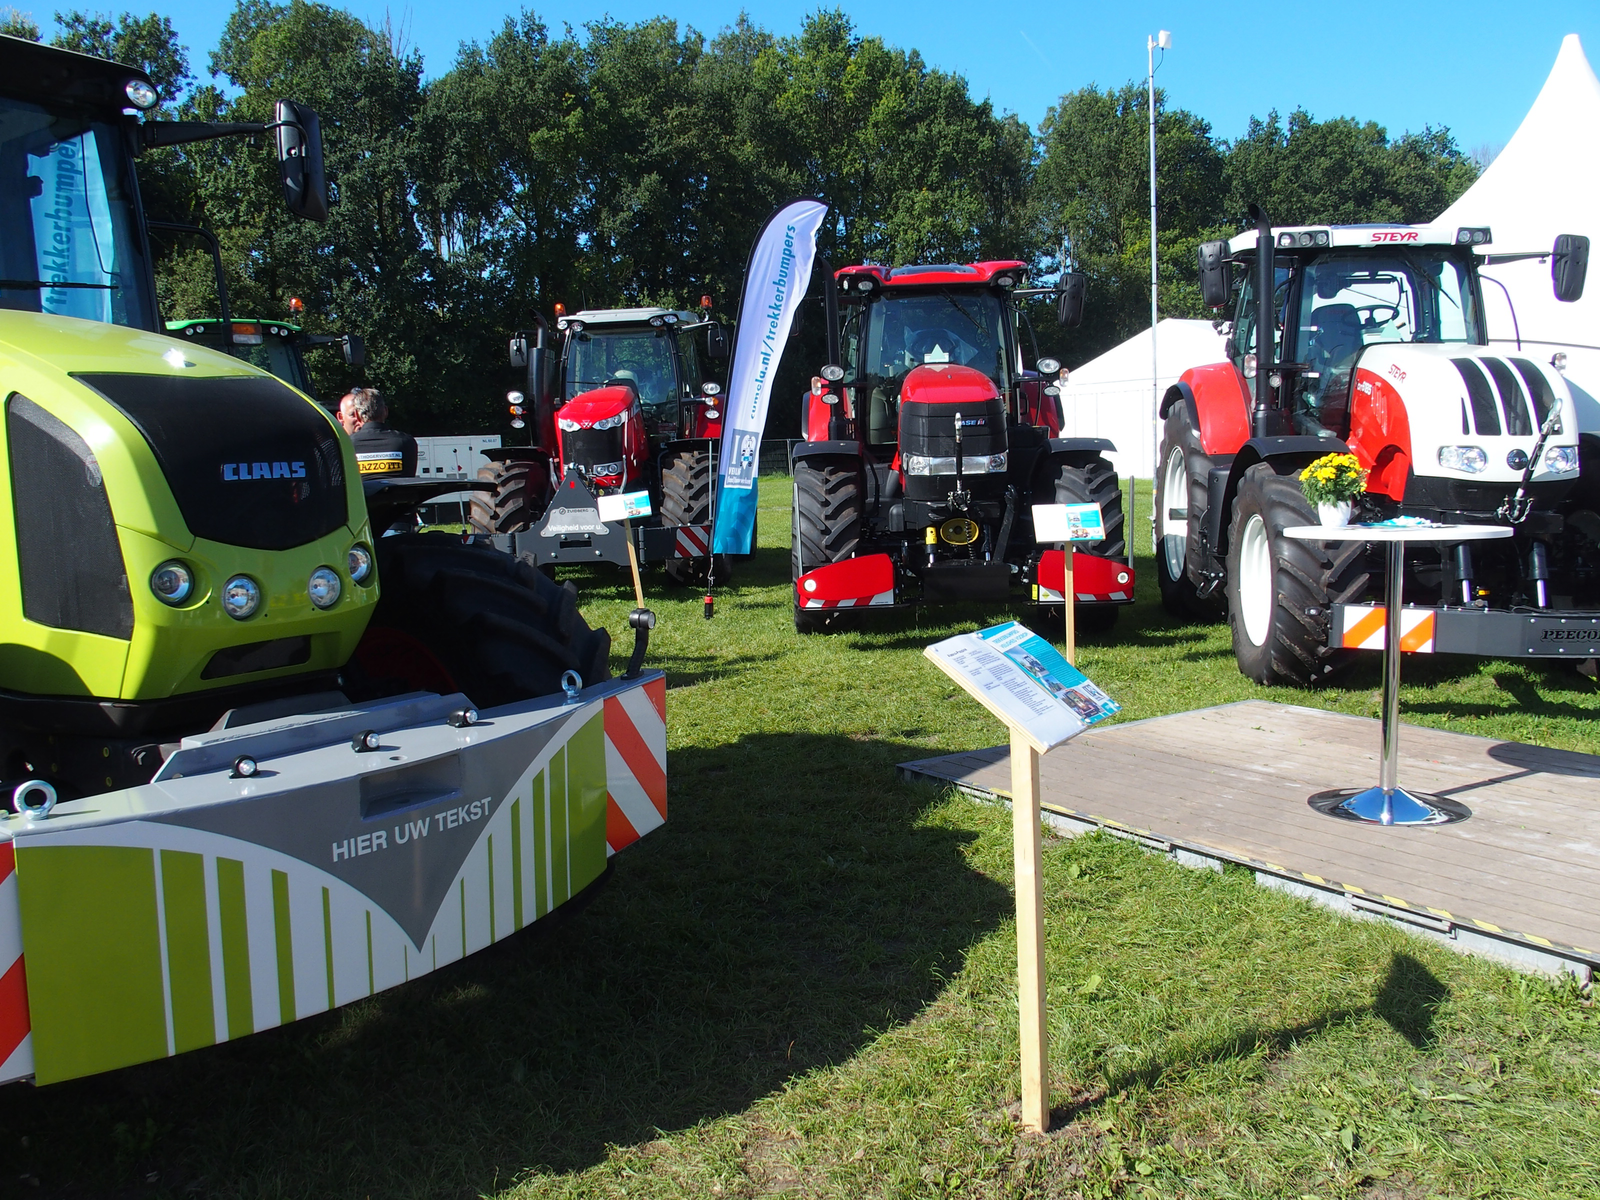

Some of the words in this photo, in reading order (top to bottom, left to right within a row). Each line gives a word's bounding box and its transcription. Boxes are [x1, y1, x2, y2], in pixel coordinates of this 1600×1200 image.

[1370, 231, 1419, 242] STEYR
[1387, 363, 1407, 384] STEYR
[223, 462, 306, 480] CLAAS
[358, 462, 402, 471] AZZOTTI
[548, 524, 579, 533] Veiligheid
[332, 830, 388, 862] HIER
[394, 816, 431, 845] UW
[434, 796, 492, 832] TEKST
